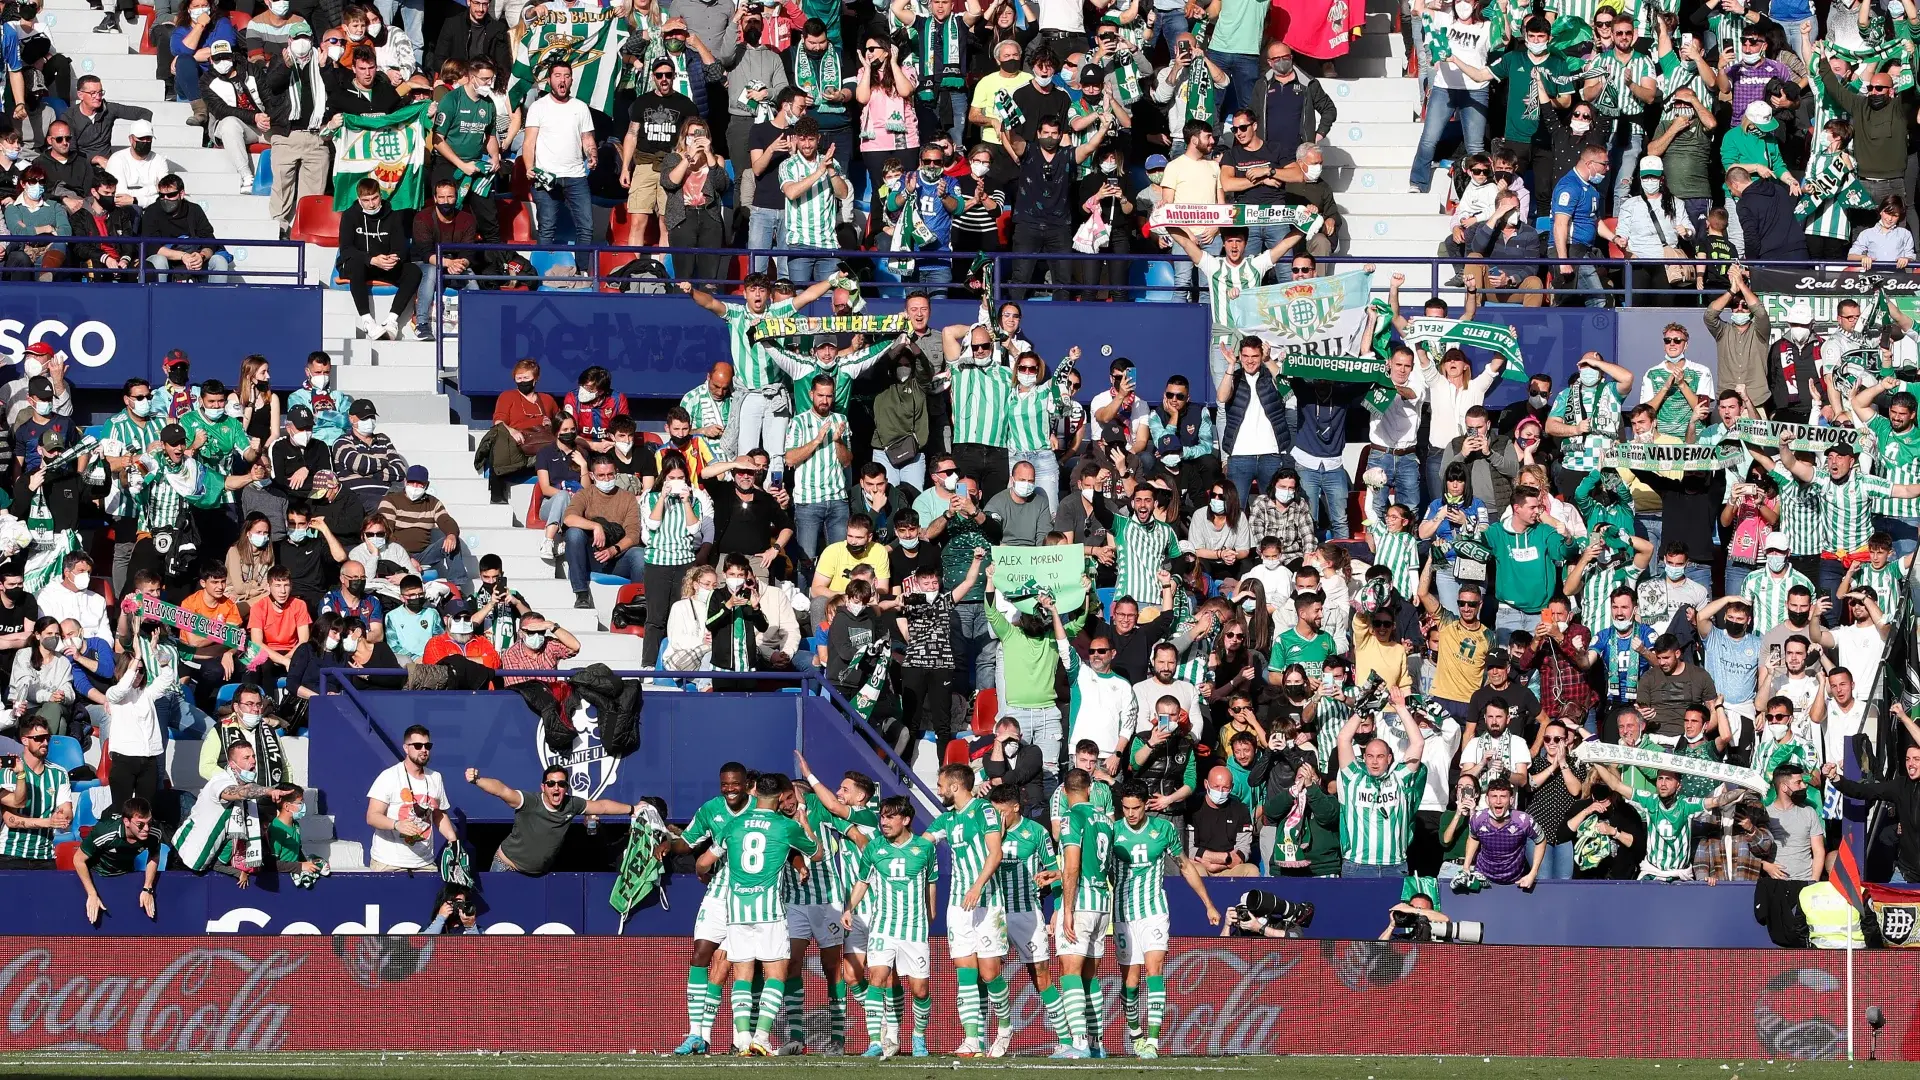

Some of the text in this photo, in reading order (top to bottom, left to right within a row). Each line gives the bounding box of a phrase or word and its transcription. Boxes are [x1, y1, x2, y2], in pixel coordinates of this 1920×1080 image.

[1739, 76, 1772, 85] betwa
[644, 121, 676, 133] familia
[1166, 209, 1220, 220] Antoniano
[1795, 277, 1838, 290] Real
[1462, 326, 1492, 339] BETIS
[998, 553, 1063, 566] ALEX MORENO
[143, 599, 197, 629] BALOMPIE
[199, 618, 228, 641] BETIS
[744, 819, 772, 831] FEKIR
[740, 831, 767, 874] 8
[868, 937, 885, 952] 28
[1117, 933, 1127, 950] 5
